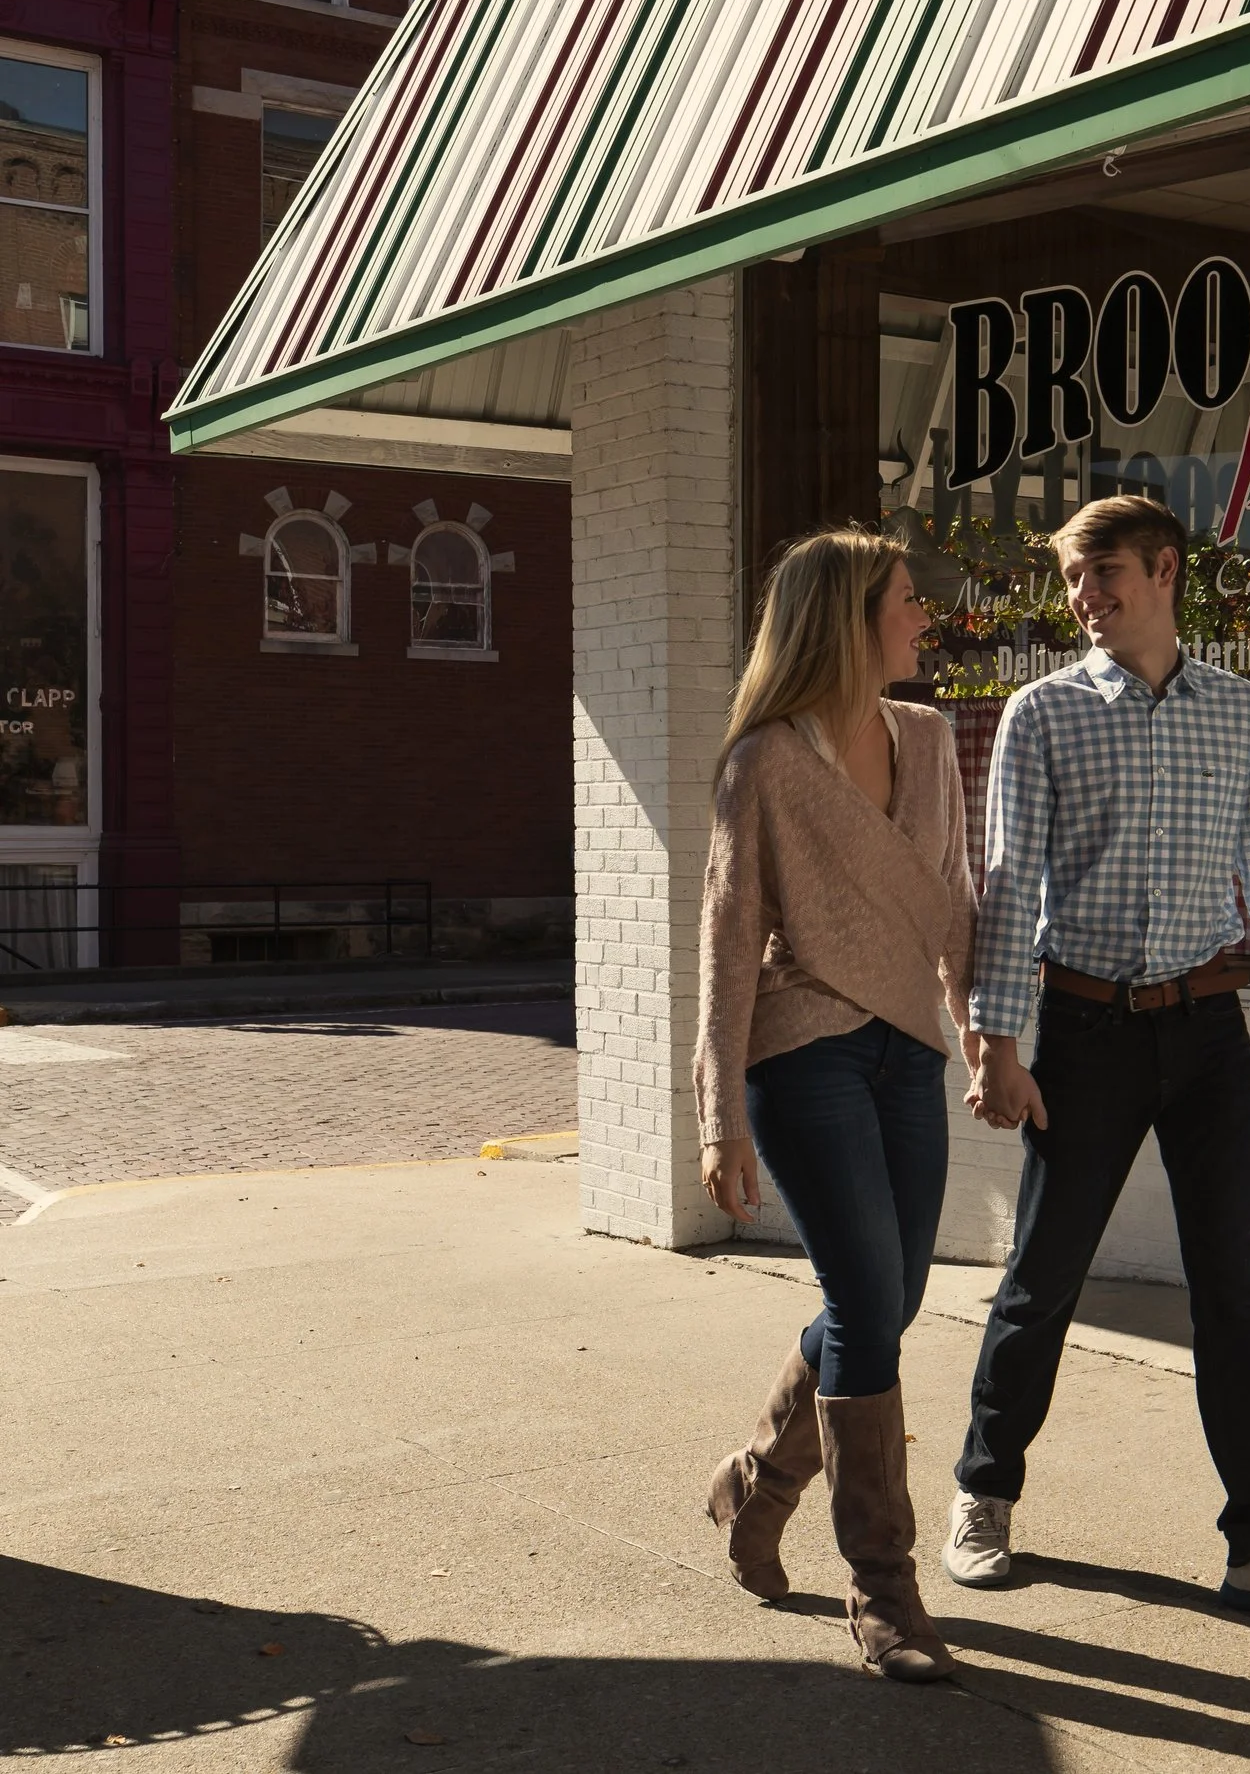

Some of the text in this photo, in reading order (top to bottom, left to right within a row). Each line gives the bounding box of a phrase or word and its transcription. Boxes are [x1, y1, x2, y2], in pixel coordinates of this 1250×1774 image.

[936, 576, 1012, 620] New
[1022, 570, 1068, 619] Yo
[997, 643, 1088, 682] Delive
[6, 687, 76, 708] CLAPP
